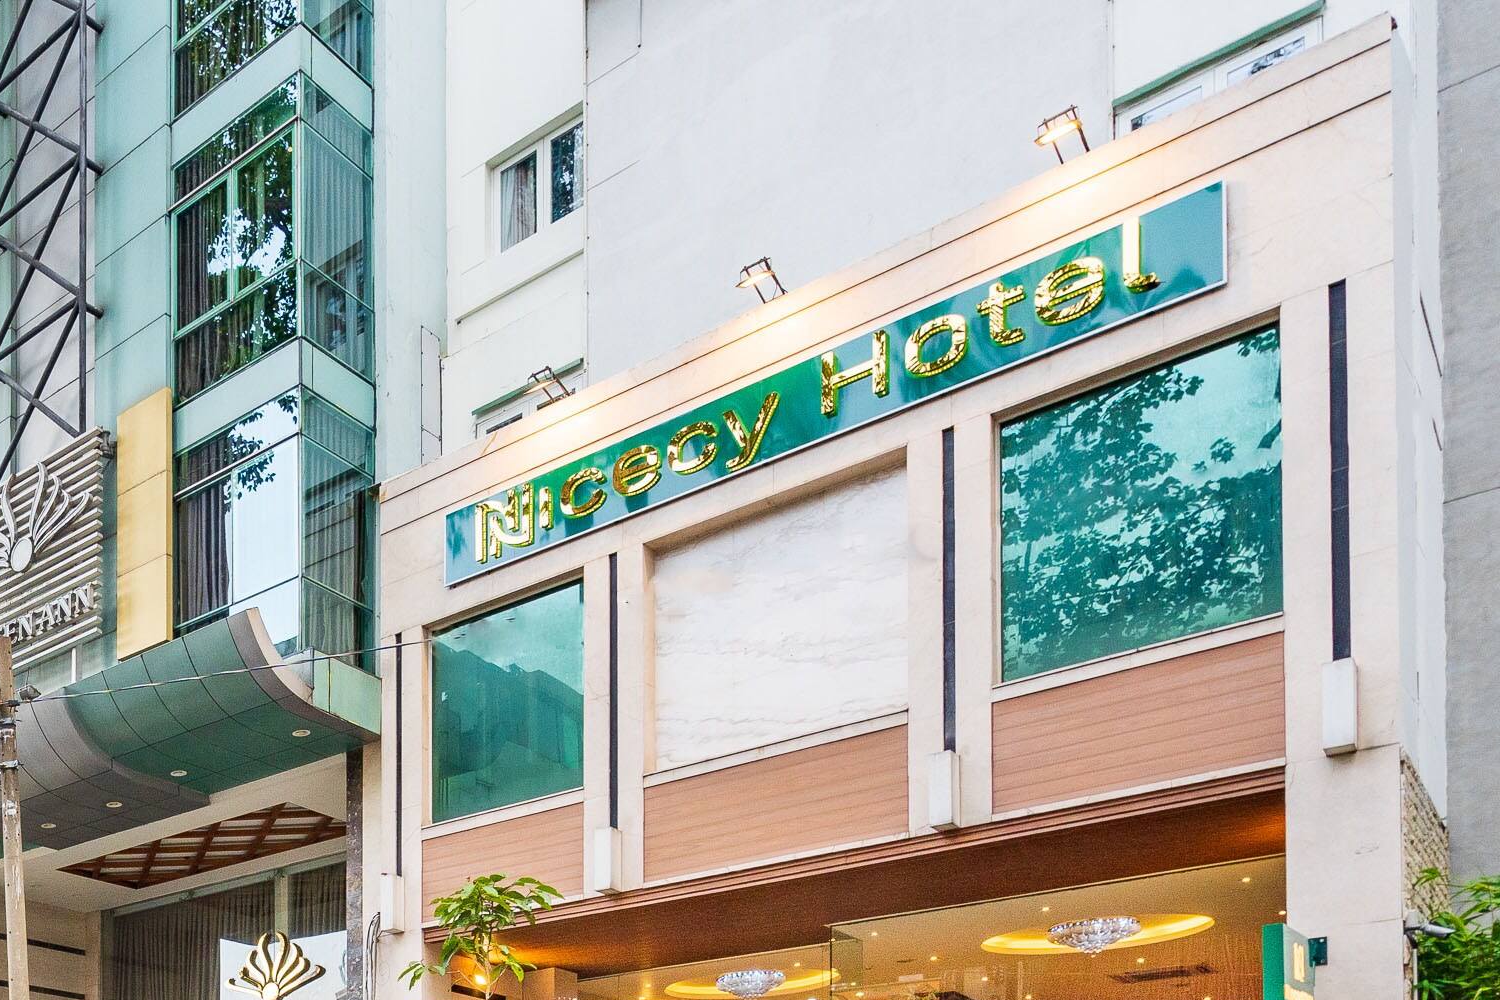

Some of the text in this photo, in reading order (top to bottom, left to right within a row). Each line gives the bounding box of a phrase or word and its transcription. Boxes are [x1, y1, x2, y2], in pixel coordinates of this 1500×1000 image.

[474, 216, 1162, 564] Nicecy Hotel
[38, 582, 95, 630] ANN
